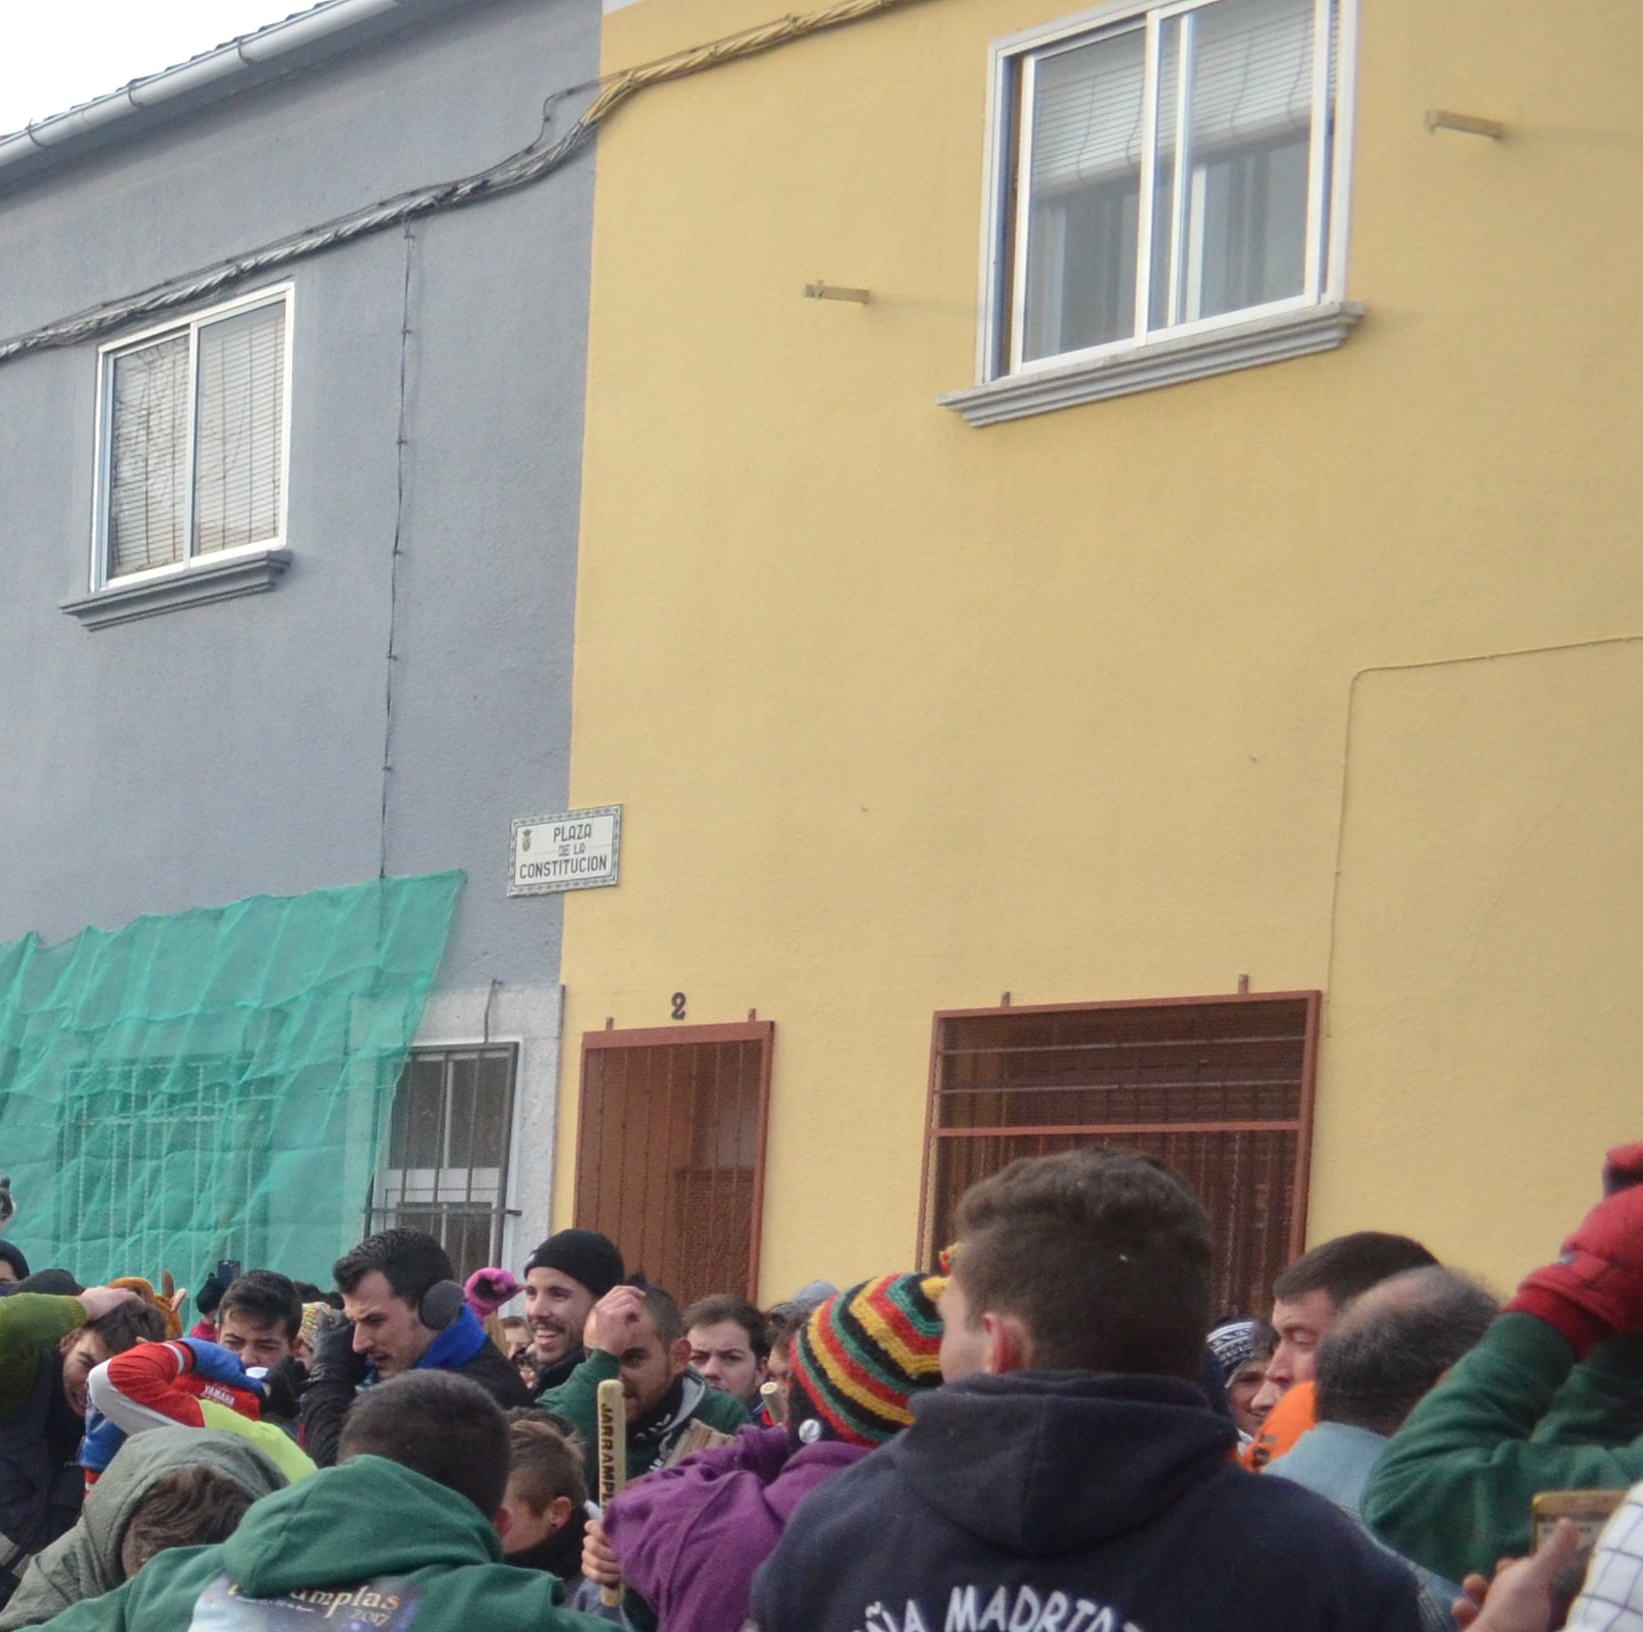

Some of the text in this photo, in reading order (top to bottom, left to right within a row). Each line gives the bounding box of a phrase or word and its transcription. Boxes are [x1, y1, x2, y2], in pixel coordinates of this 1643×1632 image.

[553, 823, 592, 843] PLAZA
[558, 843, 585, 857] DE LA
[519, 855, 607, 880] CONSTITUCION
[671, 992, 686, 1020] 2
